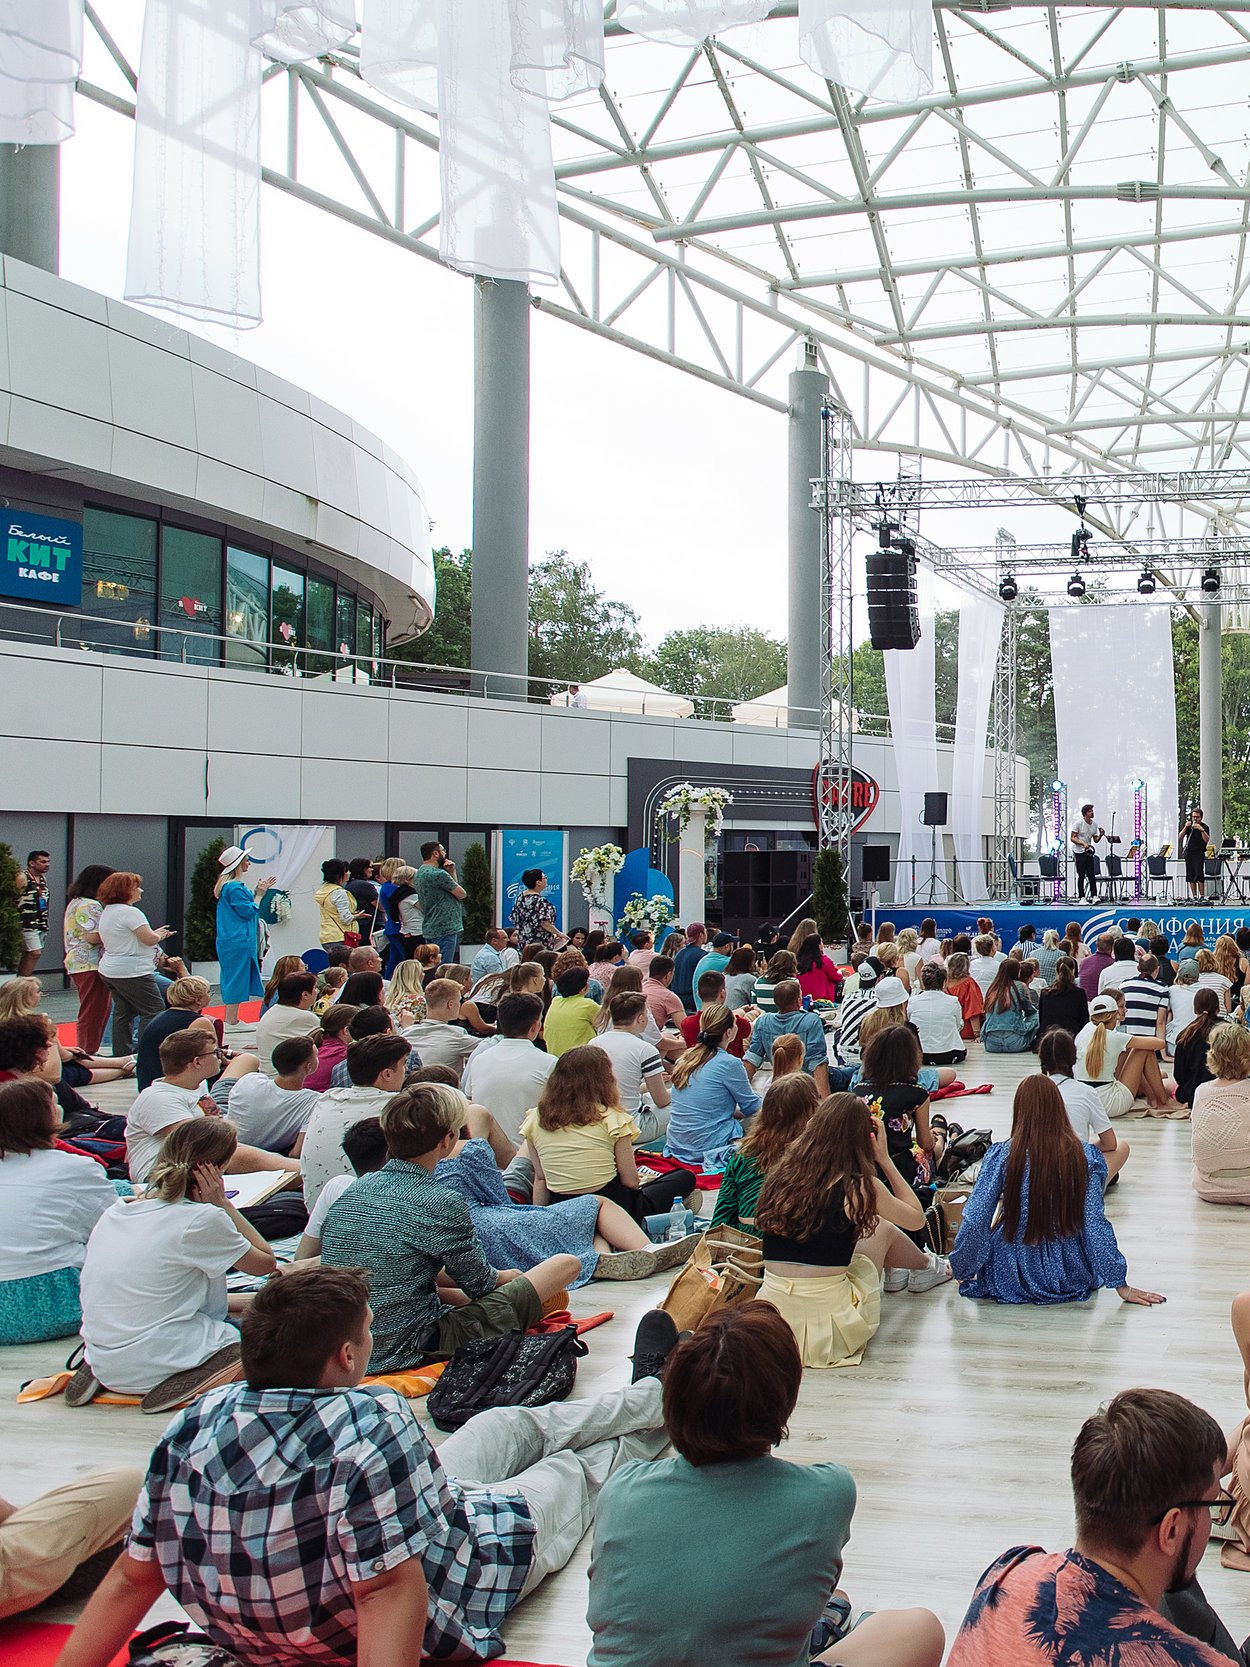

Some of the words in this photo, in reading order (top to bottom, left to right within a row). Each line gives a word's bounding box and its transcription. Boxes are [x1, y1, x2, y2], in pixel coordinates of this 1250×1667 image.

[8, 524, 71, 545] Белый
[7, 538, 71, 571] КИТ
[18, 567, 59, 583] КАФЕ
